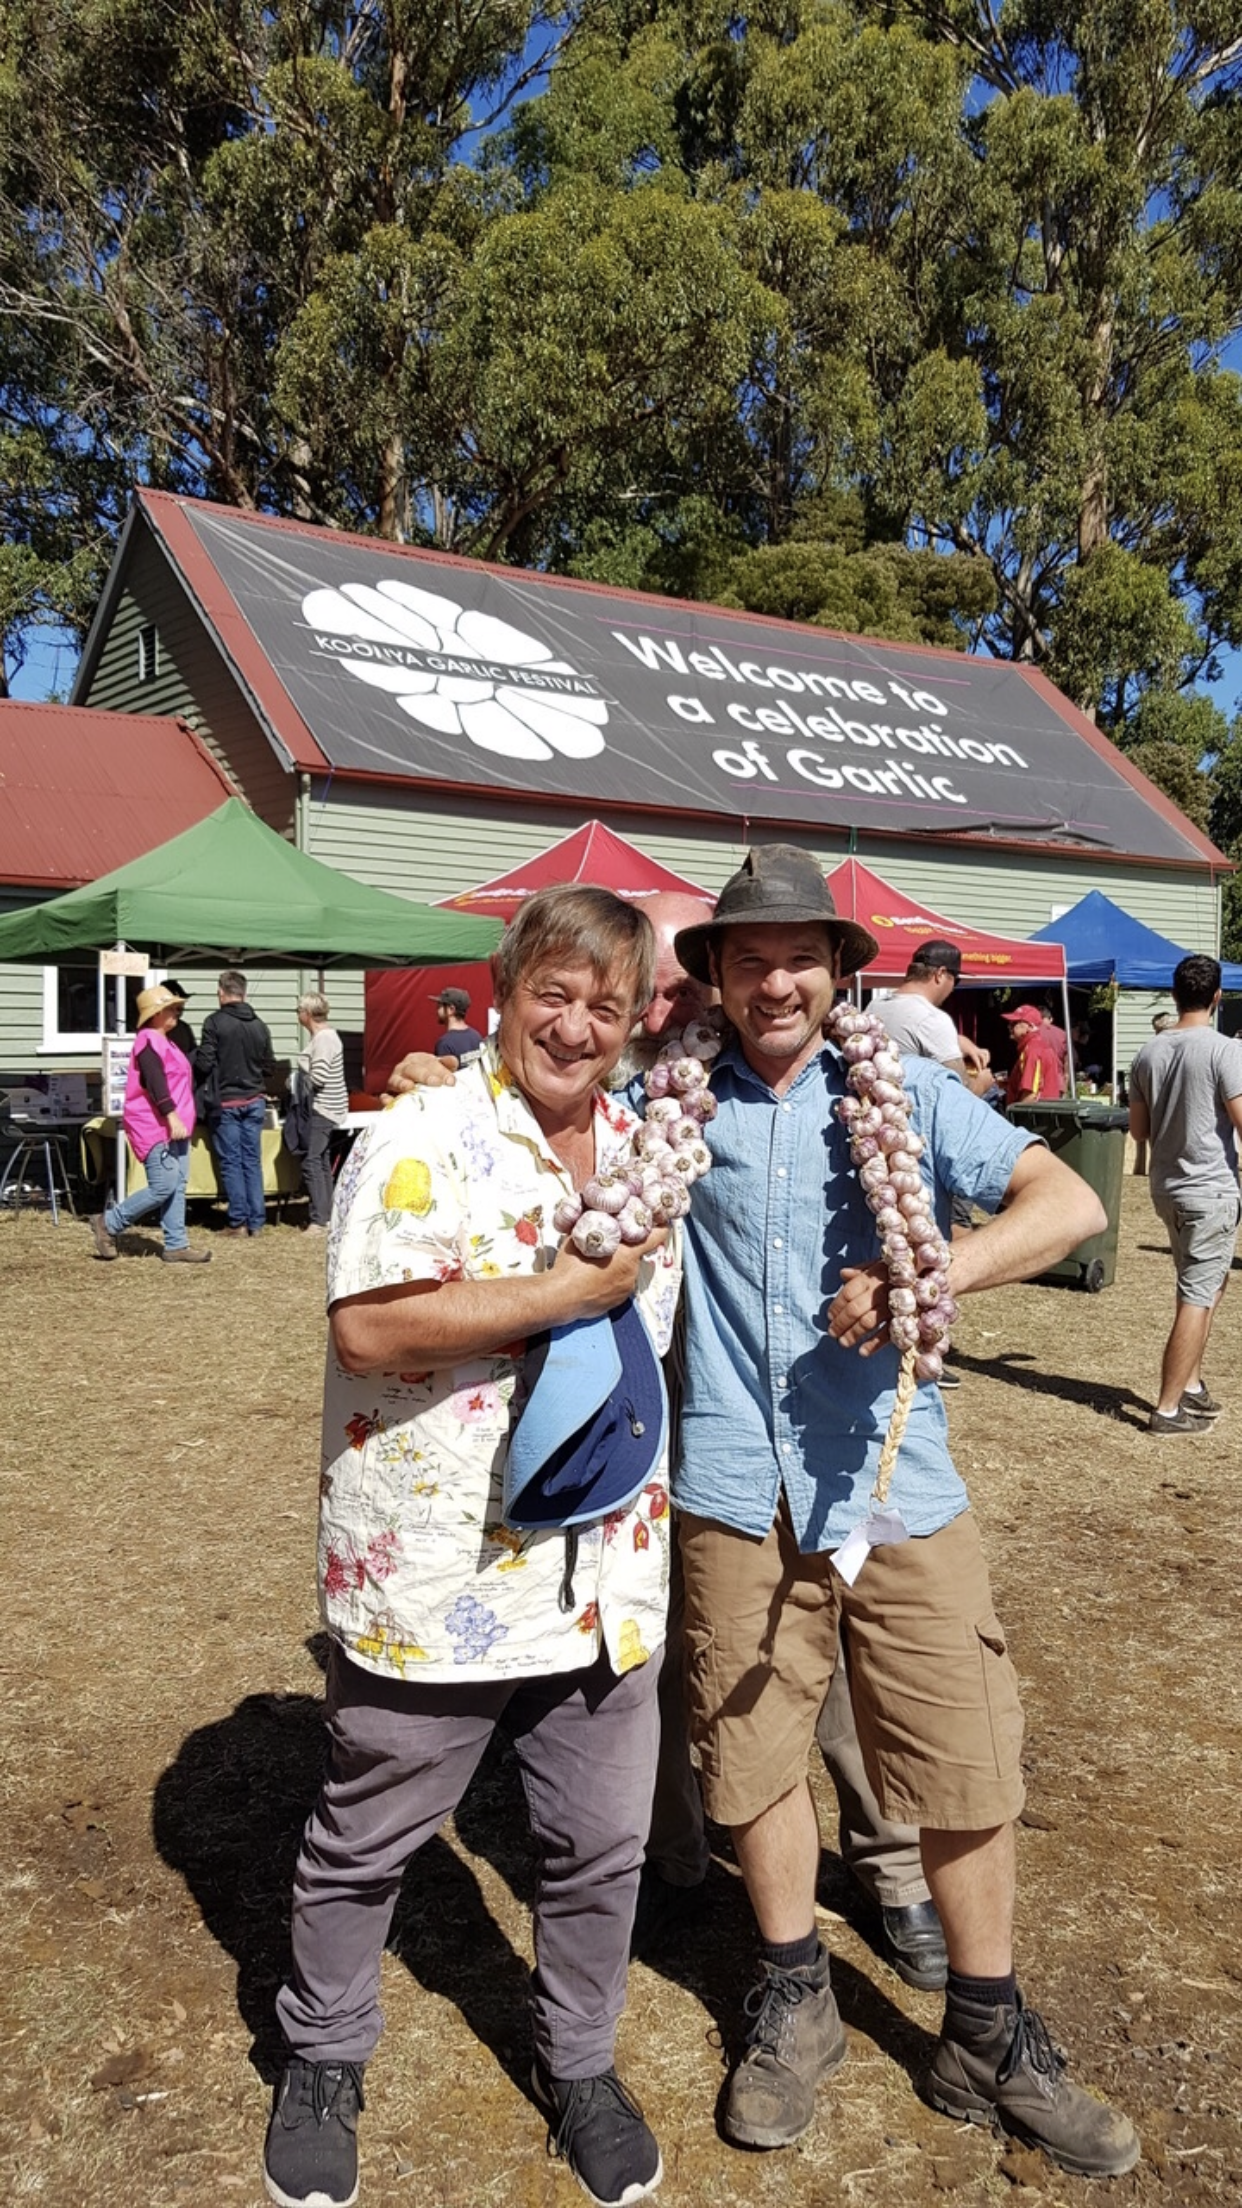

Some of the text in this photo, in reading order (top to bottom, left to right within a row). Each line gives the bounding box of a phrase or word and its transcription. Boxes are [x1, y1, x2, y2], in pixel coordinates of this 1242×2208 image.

[426, 656, 507, 682] GARLIC
[508, 670, 600, 695] FESTIVAL
[611, 631, 948, 716] Welcome to
[666, 695, 1029, 768] a celebration
[711, 741, 968, 803] of Garlic
[960, 952, 990, 964] mething
